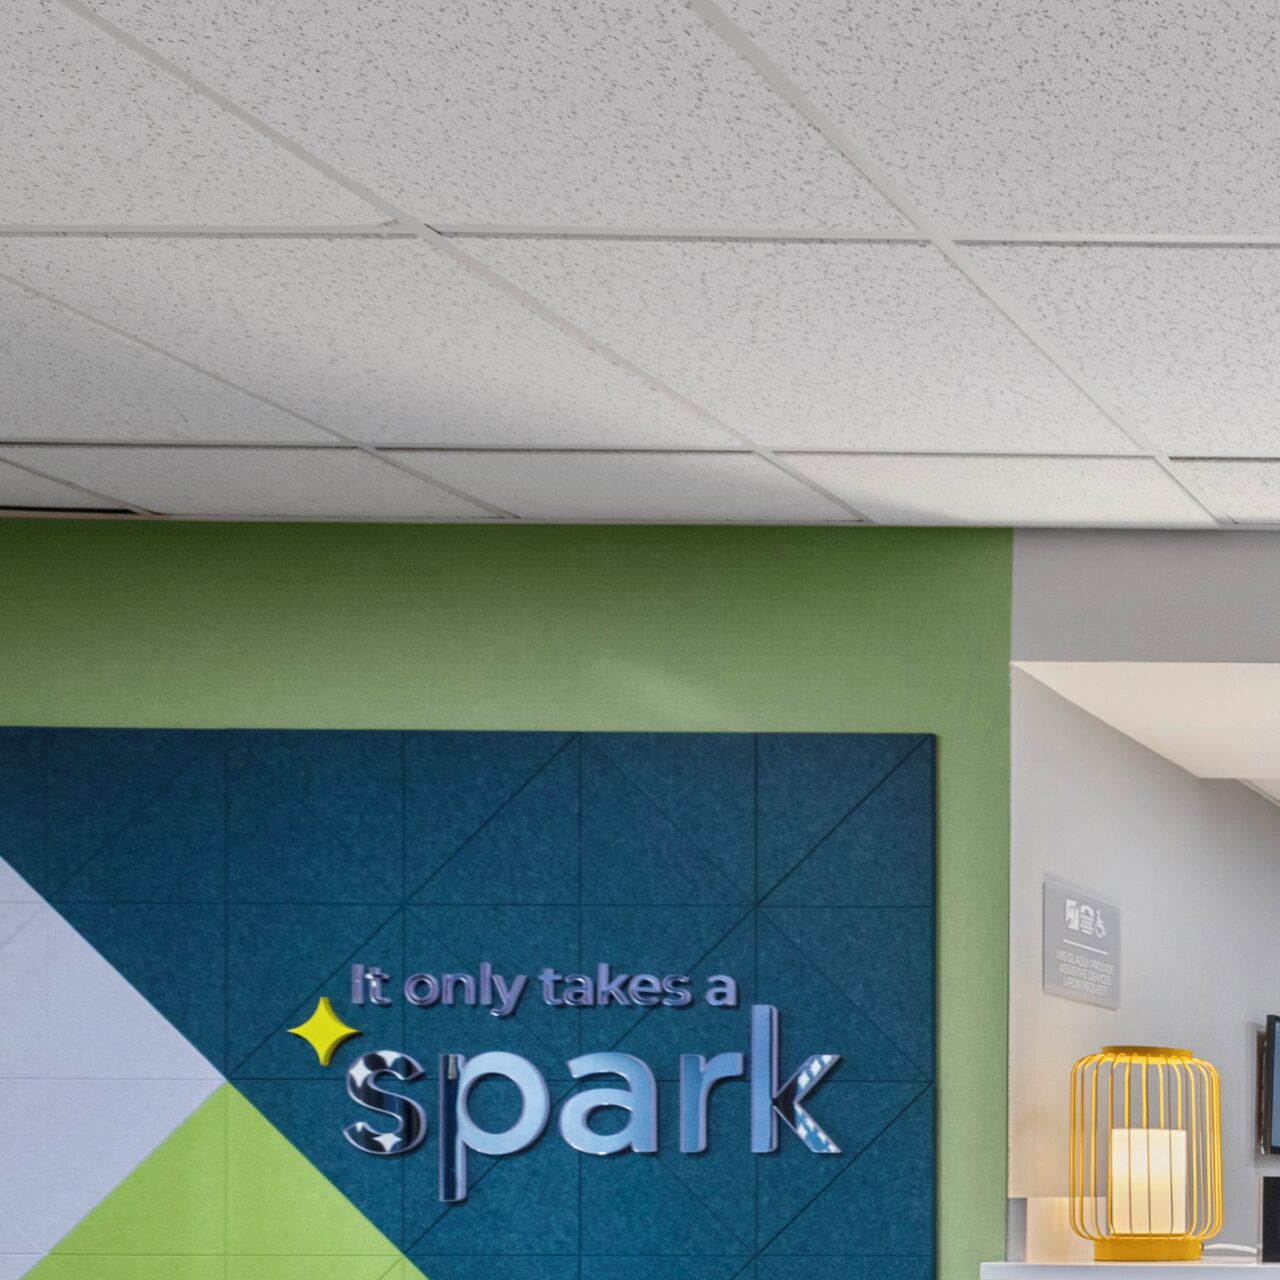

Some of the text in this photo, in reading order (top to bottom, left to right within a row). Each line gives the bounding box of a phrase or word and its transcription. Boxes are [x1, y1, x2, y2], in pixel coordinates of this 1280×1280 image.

[351, 962, 739, 1017] It only takes a
[343, 1004, 842, 1203] spark
